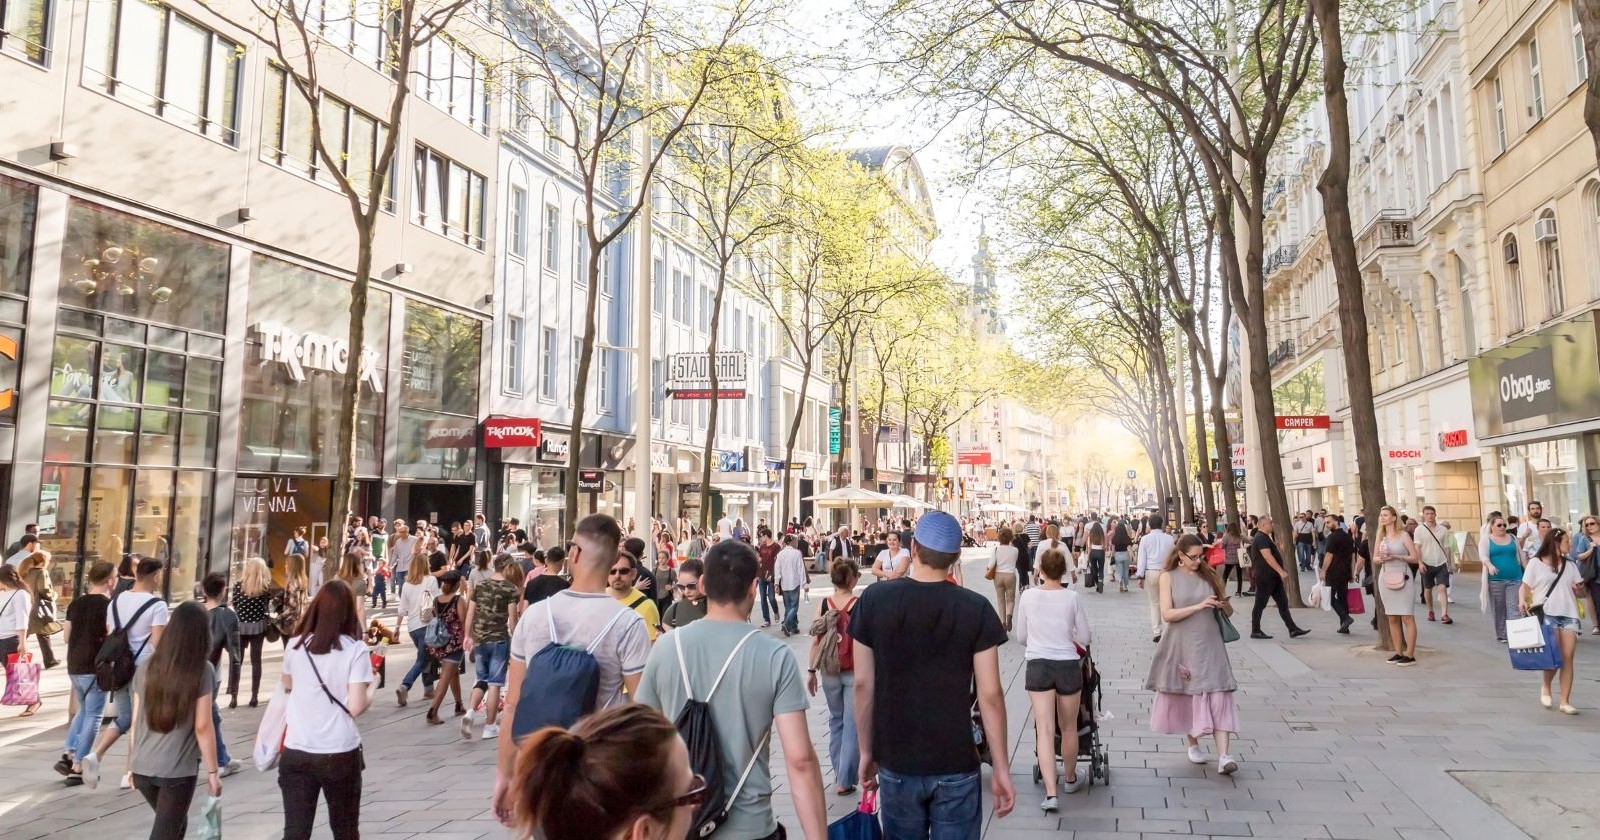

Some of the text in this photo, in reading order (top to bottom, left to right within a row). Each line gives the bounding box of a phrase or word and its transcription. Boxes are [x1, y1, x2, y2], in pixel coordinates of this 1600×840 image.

[678, 356, 743, 378] STADSAAL
[1510, 373, 1534, 403] bag
[1285, 418, 1314, 427] CAMPER
[1388, 450, 1421, 458] BOSCH
[243, 496, 297, 513] VIENNA
